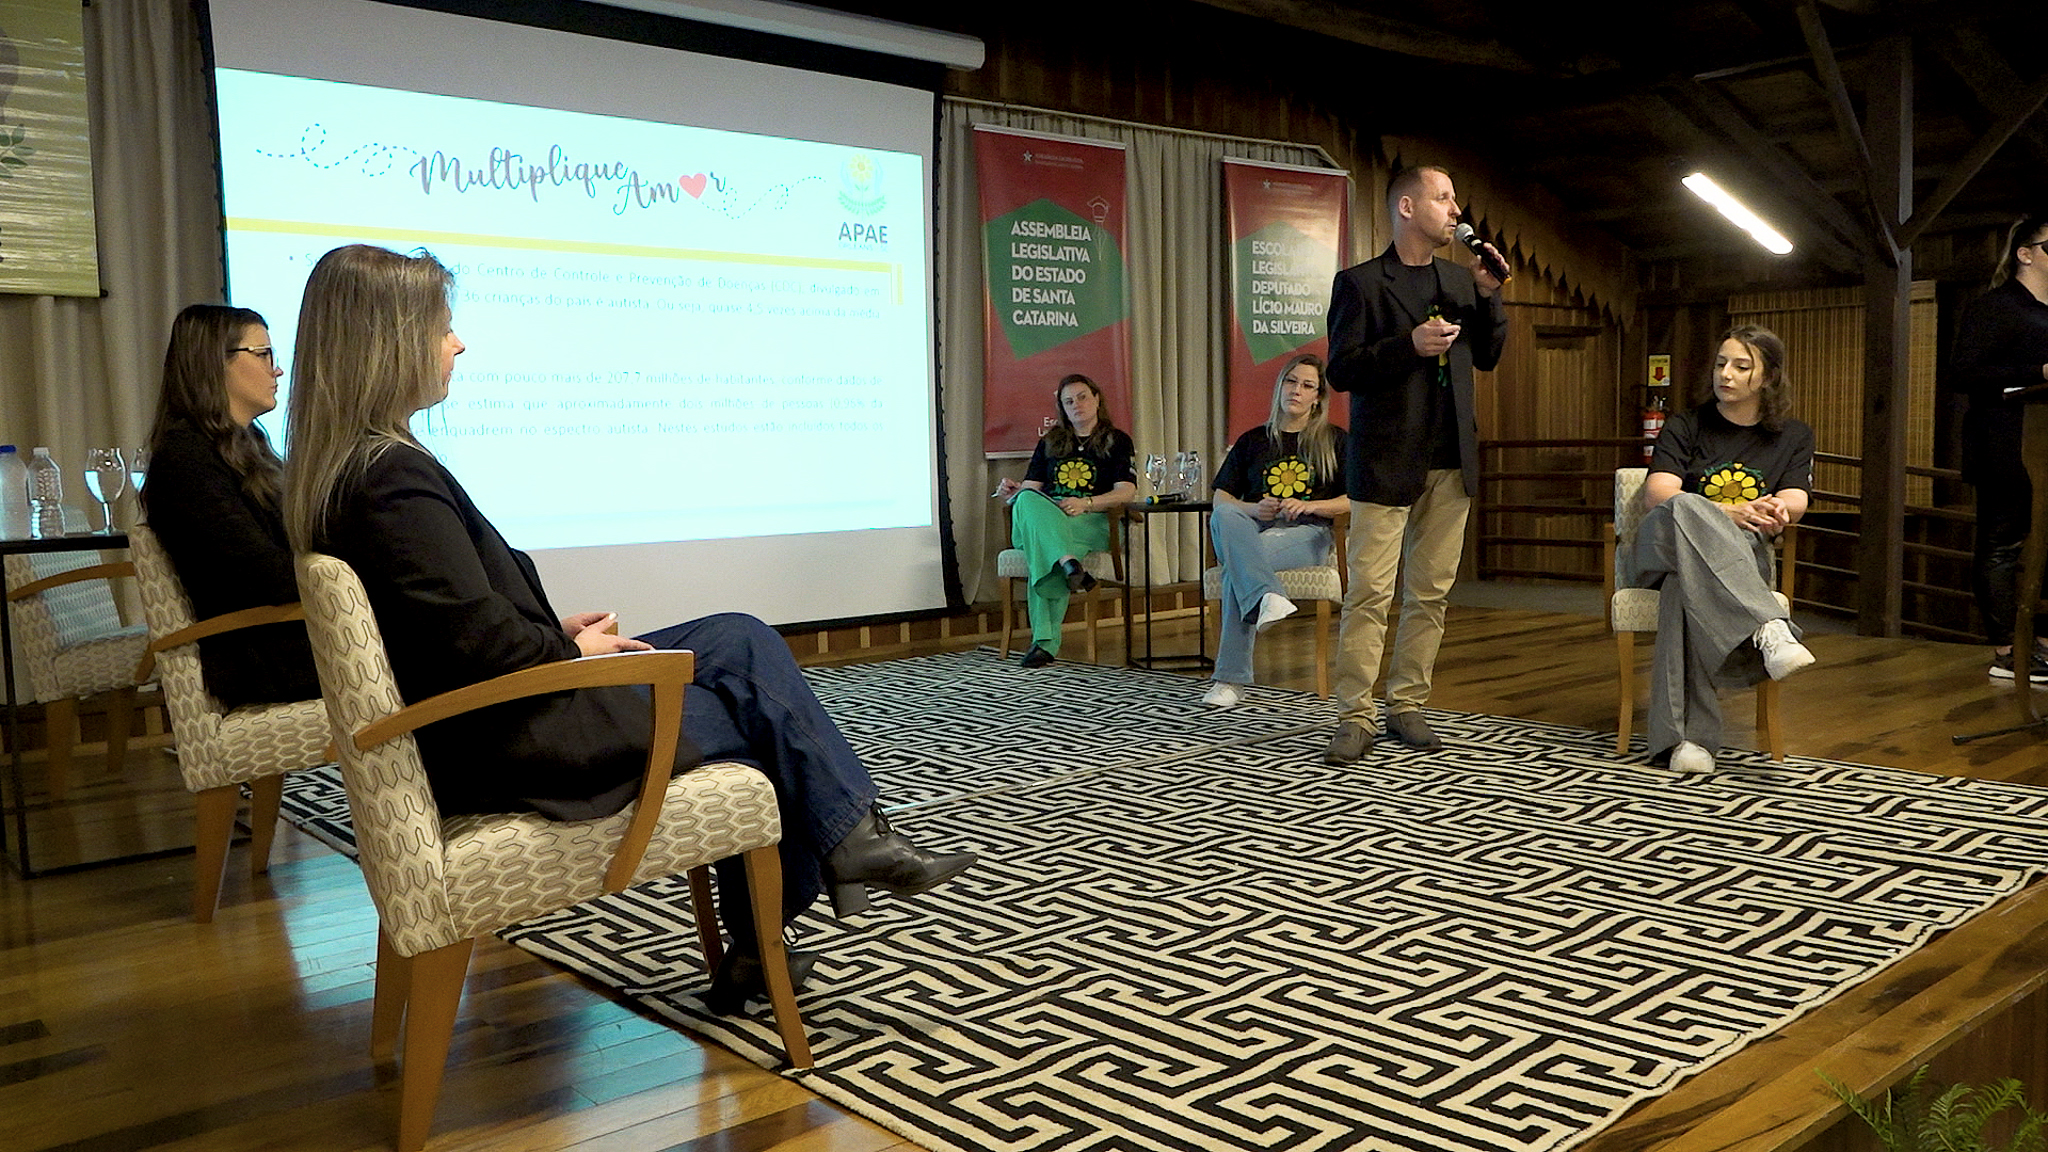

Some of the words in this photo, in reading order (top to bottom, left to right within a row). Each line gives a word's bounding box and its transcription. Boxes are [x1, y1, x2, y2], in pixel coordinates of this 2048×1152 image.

[409, 143, 628, 203] Multiplique
[838, 221, 888, 244] APAE
[1011, 220, 1092, 241] ASSEMBLEIA
[1011, 242, 1091, 263] LEGISLATIVA
[477, 262, 524, 278] Centro
[530, 266, 547, 279] de
[554, 267, 609, 282] Controle
[616, 273, 623, 282] e
[629, 272, 692, 288] Prevenção
[697, 276, 712, 287] de
[718, 276, 766, 292] Doenças
[810, 283, 859, 297] divulgado
[864, 287, 880, 296] em
[1011, 265, 1034, 281] DO
[1036, 266, 1086, 283] ESTADO
[1012, 287, 1031, 303] DE
[1033, 288, 1076, 305] SANTA
[1252, 280, 1311, 297] DEPUTADO
[462, 289, 480, 303] 36
[485, 291, 540, 306] crianças
[545, 293, 562, 305] do
[657, 298, 674, 310] Ou
[709, 303, 742, 315] quase
[768, 306, 796, 317] vezes
[800, 307, 830, 317] acima
[833, 306, 846, 318] da
[1252, 296, 1283, 315] LÍCIO
[1284, 301, 1323, 316] MAURO
[1012, 309, 1079, 327] CATARINA
[1252, 319, 1269, 334] DA
[1270, 319, 1316, 335] SILVEIRA
[470, 373, 498, 382] com
[505, 372, 546, 384] pouco
[551, 372, 580, 382] mais
[586, 371, 602, 382] de
[646, 372, 693, 384] milhões
[697, 373, 711, 384] de
[782, 374, 833, 385] conforme
[836, 374, 866, 386] dados
[869, 374, 882, 385] de
[467, 398, 514, 409] estima
[523, 400, 548, 411] que
[557, 398, 672, 410] aproximadamente
[679, 398, 703, 409] dois
[710, 397, 753, 410] milhões
[761, 398, 775, 409] de
[782, 399, 824, 411] pessoas
[870, 398, 883, 409] da
[431, 424, 512, 437] enquadrem
[520, 426, 537, 435] no
[544, 423, 600, 437] espectro
[658, 421, 698, 433] Nestes
[703, 421, 748, 434] estudos
[753, 422, 783, 433] estão
[839, 421, 868, 432] todos
[872, 422, 884, 432] os
